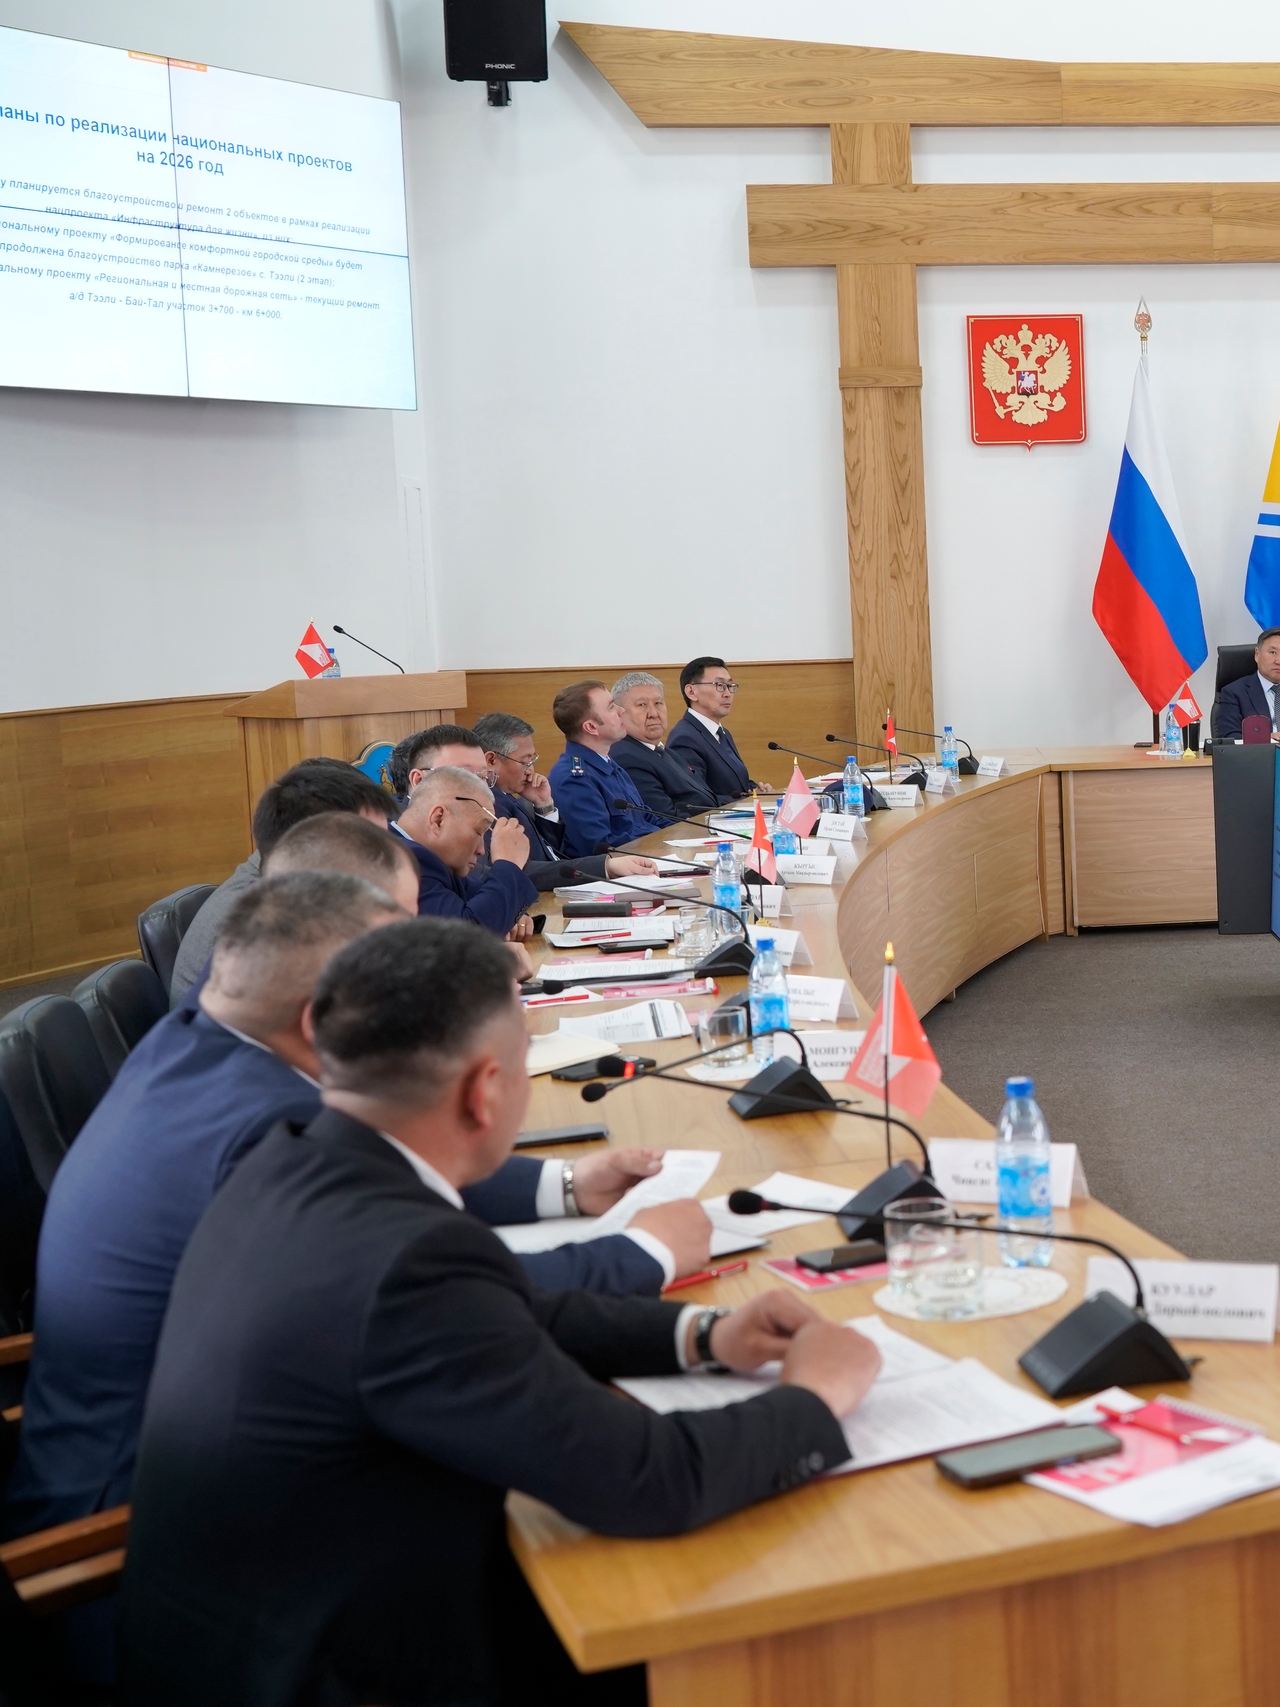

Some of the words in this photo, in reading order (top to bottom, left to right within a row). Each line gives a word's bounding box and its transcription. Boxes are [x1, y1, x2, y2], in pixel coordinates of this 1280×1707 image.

[45, 114, 65, 126] по
[71, 118, 167, 142] реализации
[173, 134, 283, 161] национальных
[288, 153, 353, 171] проектов
[137, 152, 155, 163] на
[160, 152, 194, 170] 2026
[198, 161, 224, 175] год
[9, 181, 81, 196] планируется
[83, 188, 178, 209] благоустройство
[186, 204, 223, 214] ремонт
[226, 208, 231, 216] 2
[234, 210, 279, 222] объектов
[289, 218, 319, 227] рамках
[321, 223, 370, 234] реализации
[0, 243, 64, 256] продолжена
[67, 249, 161, 266] благоустройство
[164, 261, 190, 272] парка
[192, 263, 256, 277] «Камнерезов»
[269, 271, 294, 281] Тээли
[297, 275, 305, 283] (2
[307, 277, 335, 287] этап);
[63, 229, 107, 242] проекту
[189, 244, 250, 257] комфортной
[253, 252, 299, 262] городской
[301, 257, 333, 266] среды»
[336, 260, 363, 270] будет
[47, 269, 91, 282] проекту
[94, 273, 168, 287] «Региональная
[223, 286, 267, 297] дорожная
[270, 293, 297, 301] сеть»
[305, 296, 345, 306] текущий
[347, 301, 380, 309] ремонт
[69, 292, 84, 300] а/д
[88, 293, 116, 303] Тээли
[125, 296, 163, 307] Бай-Тал
[208, 304, 234, 314] 3+700
[255, 309, 282, 319] 6+000.
